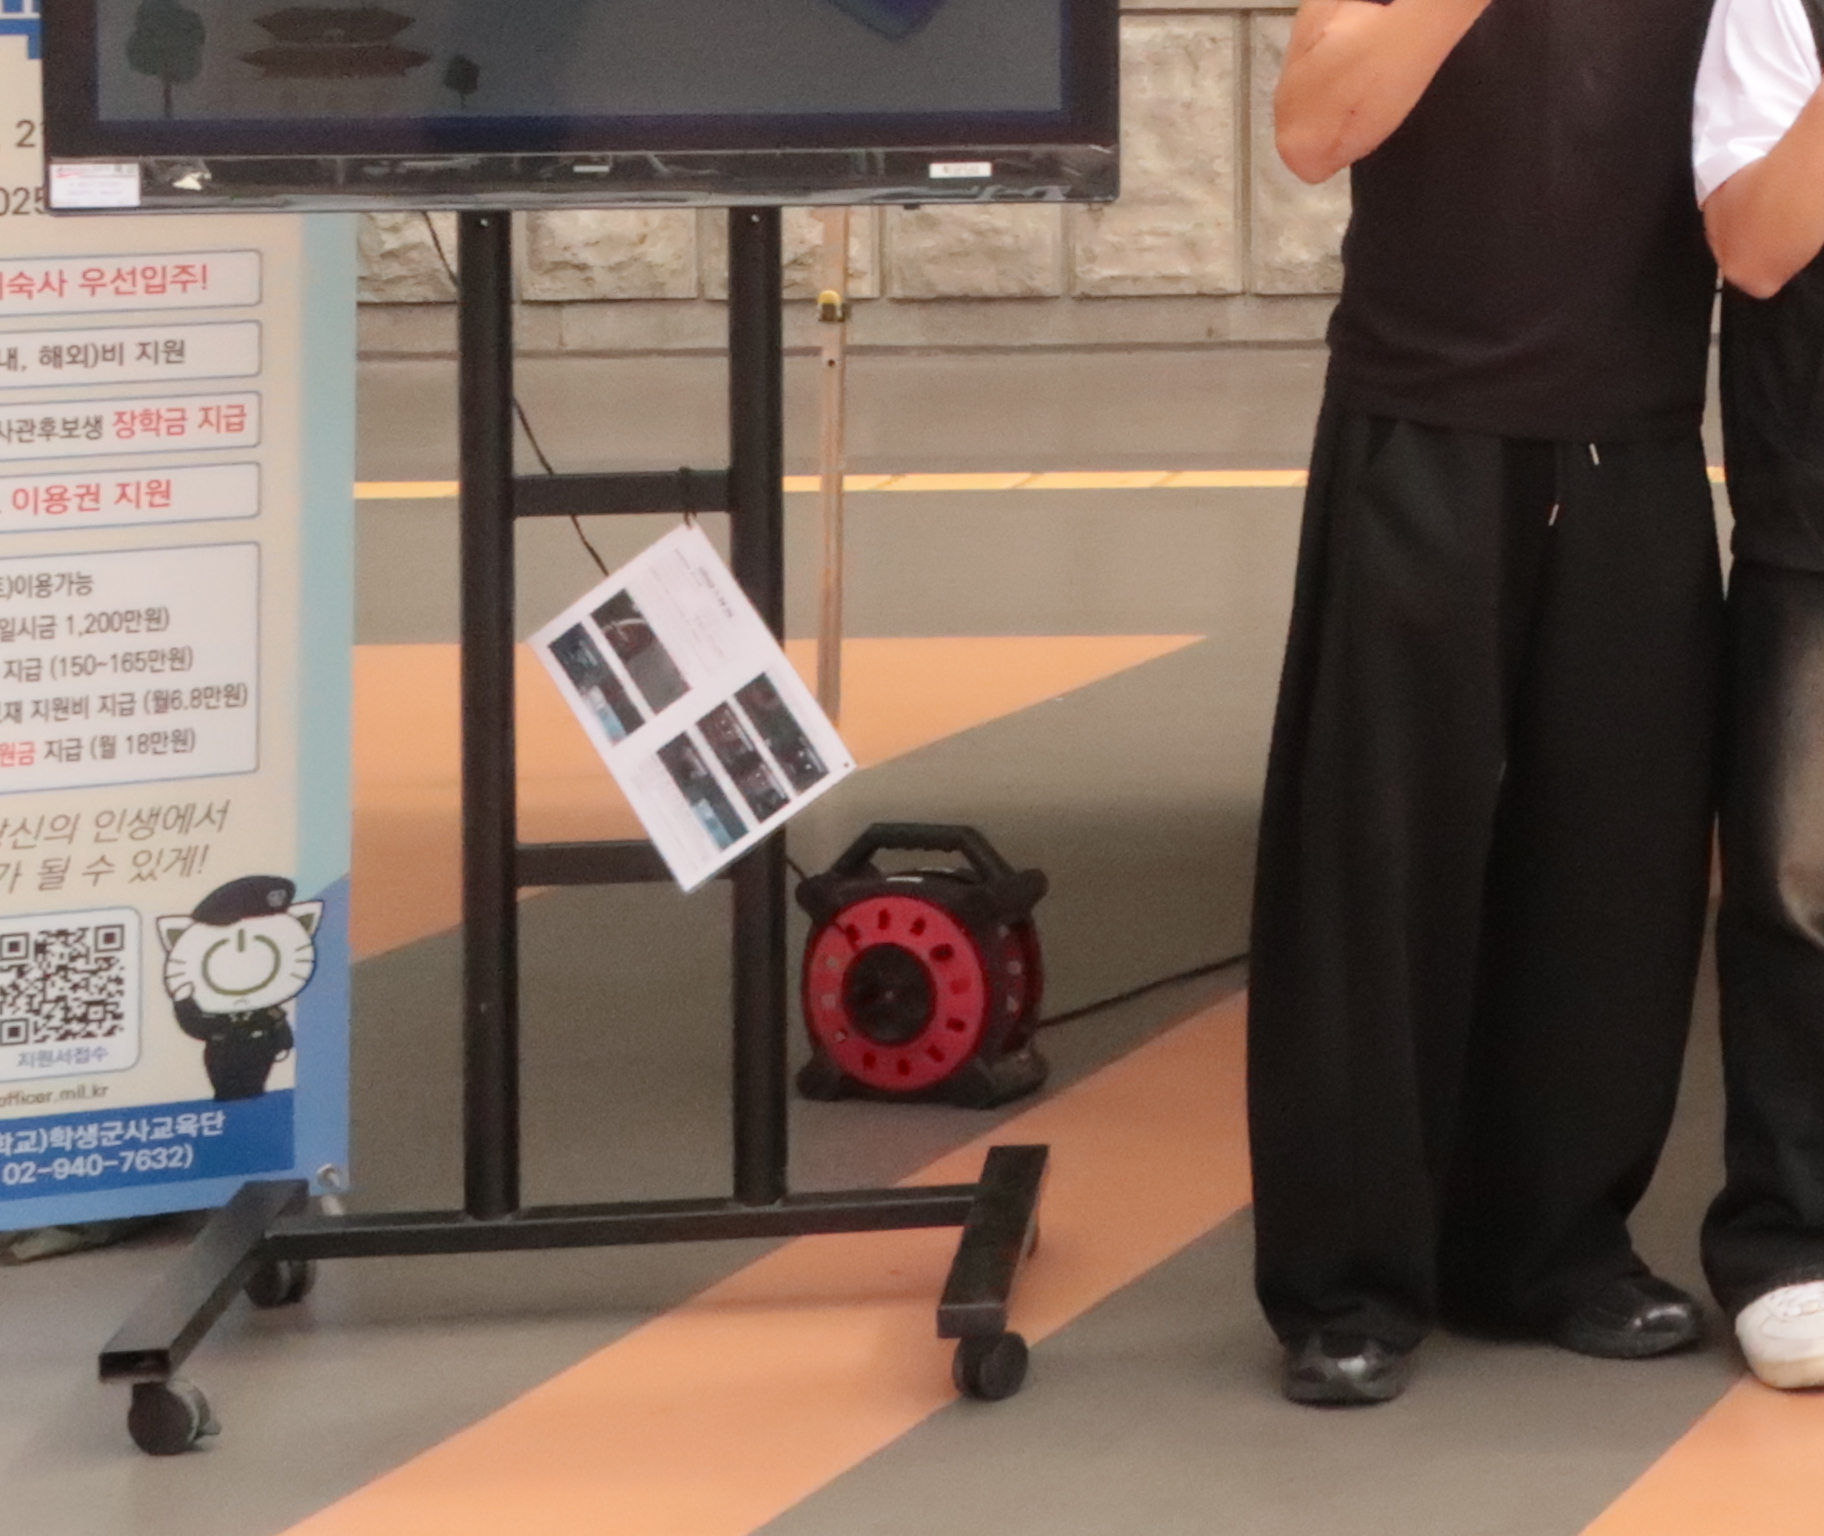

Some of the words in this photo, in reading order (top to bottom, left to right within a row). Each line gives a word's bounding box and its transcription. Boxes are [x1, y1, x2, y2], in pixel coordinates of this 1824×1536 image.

[0, 268, 69, 301] 숙사
[78, 263, 210, 298] 우선입주!
[39, 341, 125, 370] 해외)비
[135, 339, 187, 366] 지원
[112, 408, 188, 440] 장학금
[197, 404, 248, 434] 지급
[11, 482, 102, 516] 이용권
[113, 479, 173, 510] 지원
[66, 606, 171, 638] 1,200만원)
[3, 657, 43, 683] 지급
[31, 695, 91, 723] 지원비
[97, 691, 137, 718] 지급
[44, 737, 84, 764] 지급
[90, 734, 117, 761] (월
[125, 727, 197, 758] 18만원)
[93, 800, 232, 845] 인생에서
[37, 855, 72, 892] 될
[81, 853, 116, 888] 수
[127, 844, 211, 884] 있게!
[2, 1145, 194, 1186] 02-940-7632)
